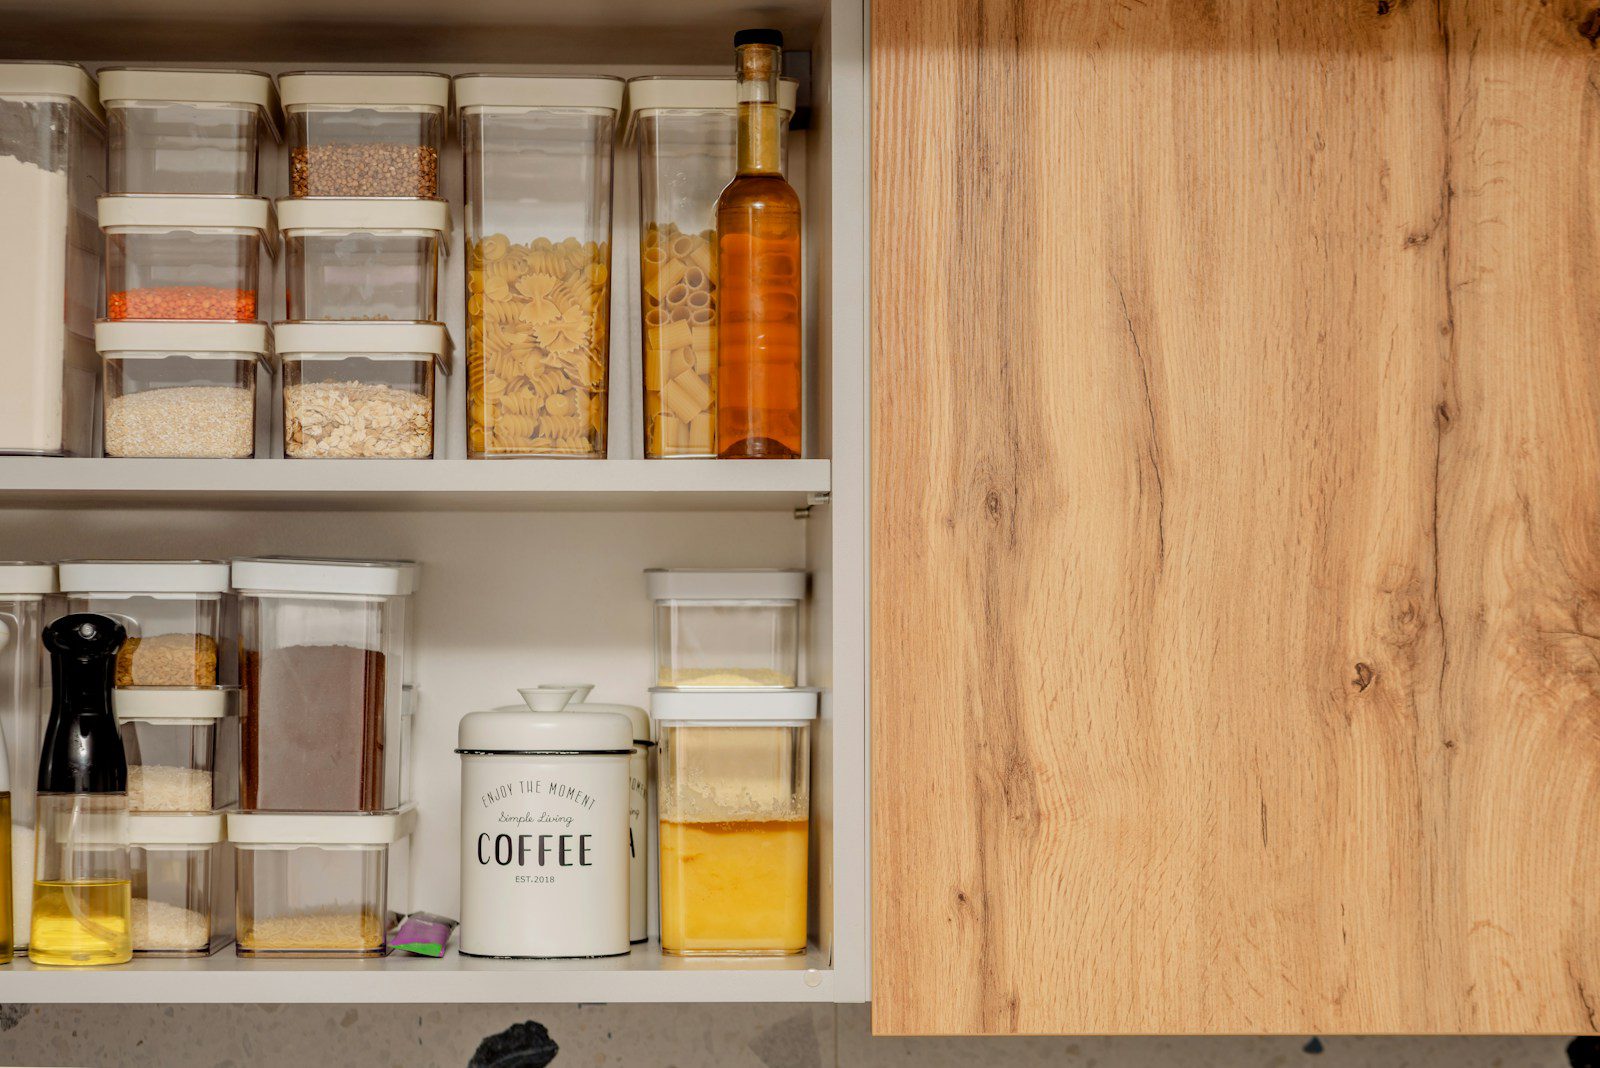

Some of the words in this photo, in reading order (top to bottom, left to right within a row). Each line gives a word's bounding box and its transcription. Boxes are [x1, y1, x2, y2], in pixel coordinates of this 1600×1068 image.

[481, 783, 513, 808] ENJOY
[520, 780, 541, 794] THE
[548, 782, 596, 810] MOMENT
[498, 811, 534, 828] Simple
[537, 811, 574, 827] Living
[477, 832, 593, 867] COFFEE
[515, 875, 555, 884] EST.2018
